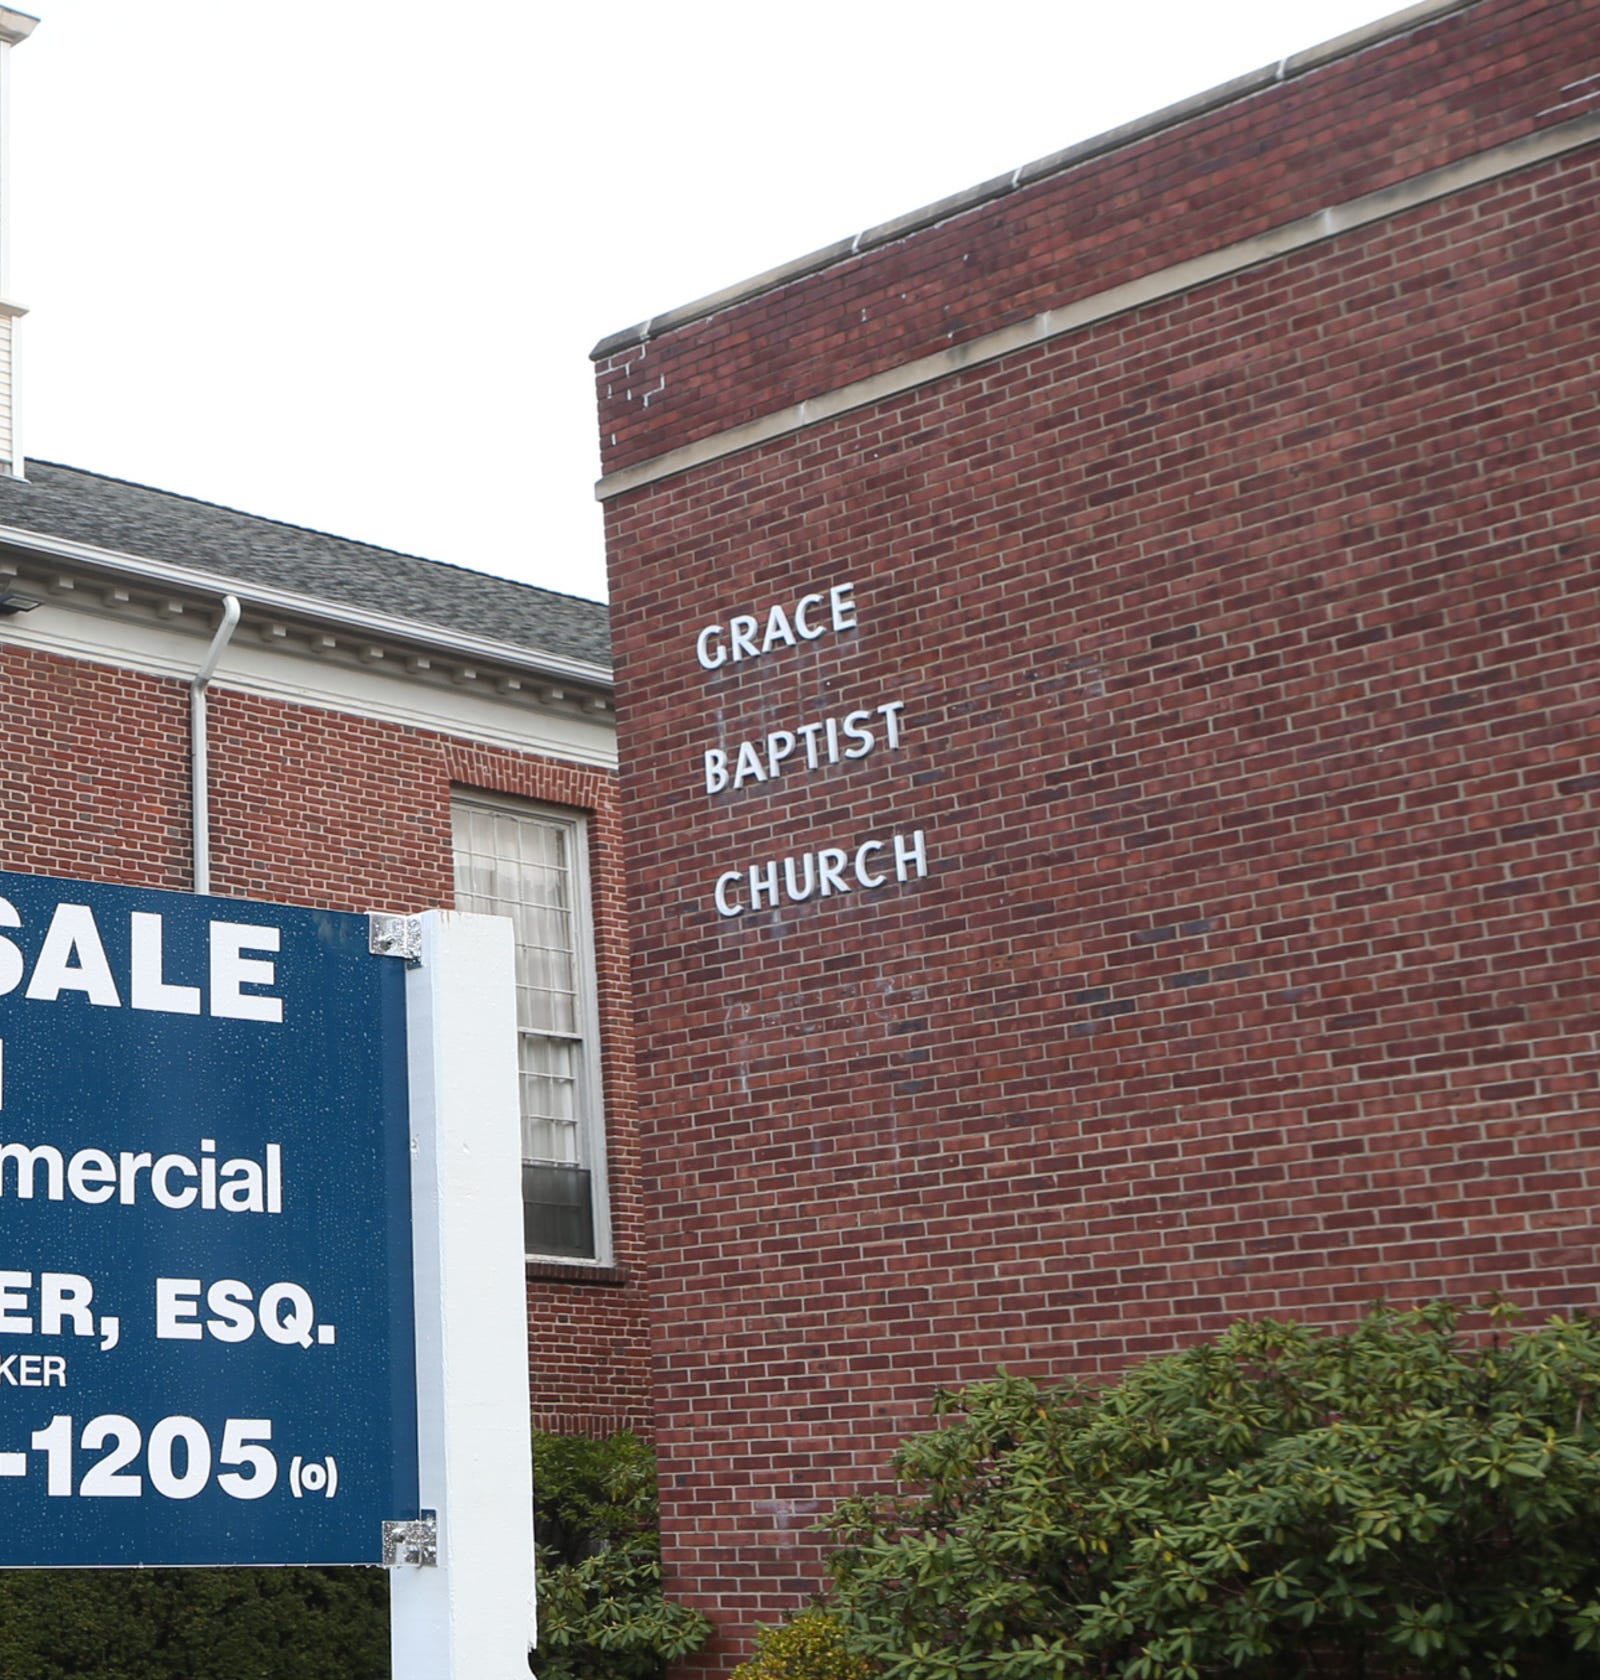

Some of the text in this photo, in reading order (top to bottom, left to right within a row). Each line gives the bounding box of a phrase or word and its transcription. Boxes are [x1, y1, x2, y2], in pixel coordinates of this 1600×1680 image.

[696, 582, 858, 671] GRACE
[704, 700, 905, 796] BAPTIST
[714, 829, 929, 917] CHURCH
[156, 1277, 335, 1349] ESQ.
